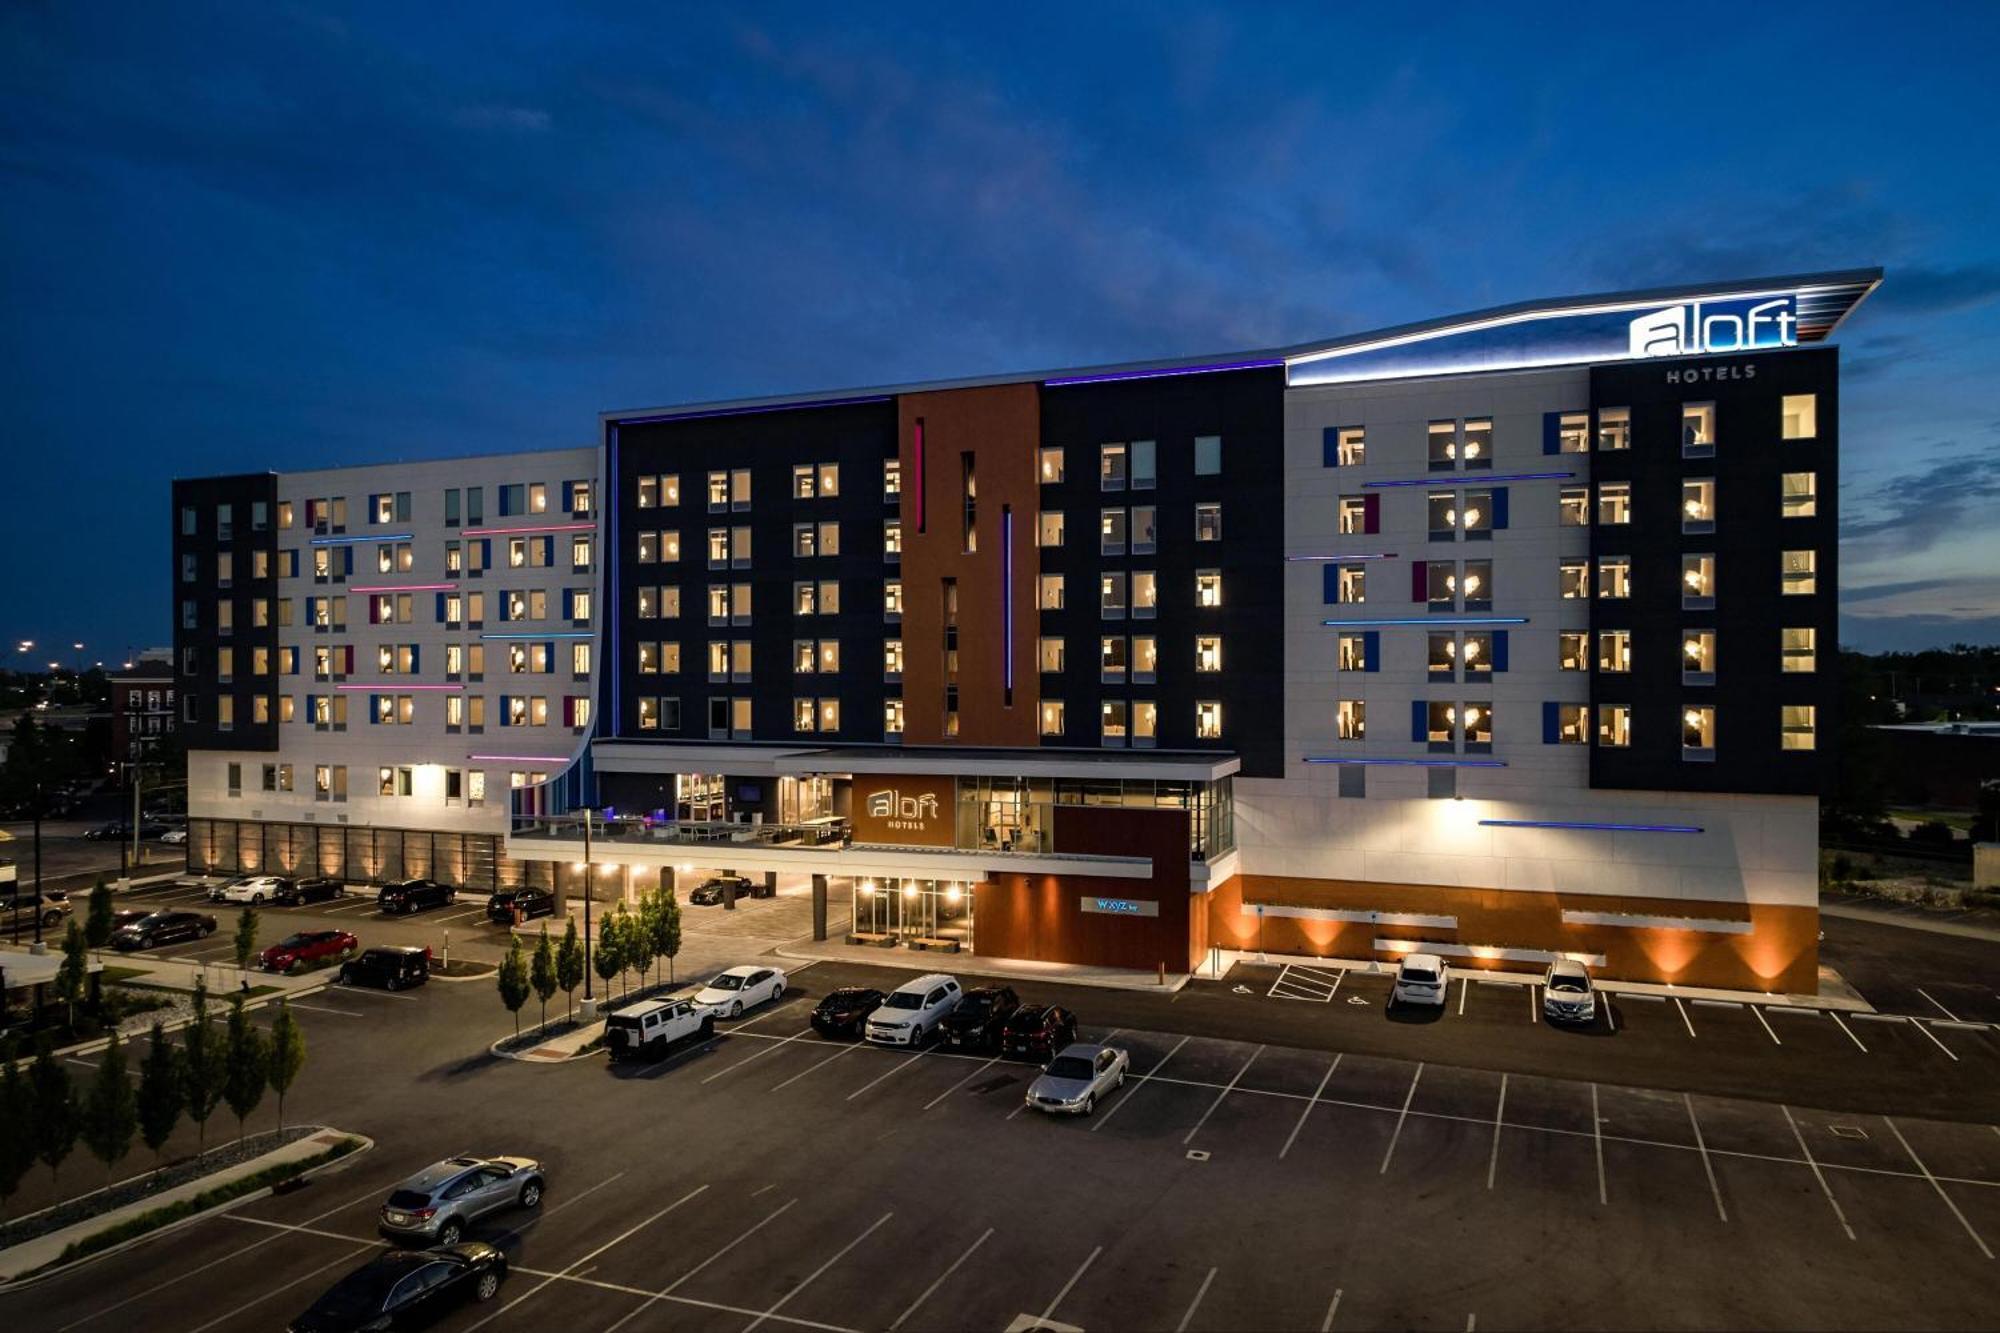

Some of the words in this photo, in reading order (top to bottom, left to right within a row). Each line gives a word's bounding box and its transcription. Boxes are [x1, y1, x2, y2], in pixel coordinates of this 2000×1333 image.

[1630, 299, 1797, 357] aloft
[1666, 365, 1757, 384] HOTELS
[867, 789, 939, 819] aloft
[887, 821, 925, 831] HOTELS
